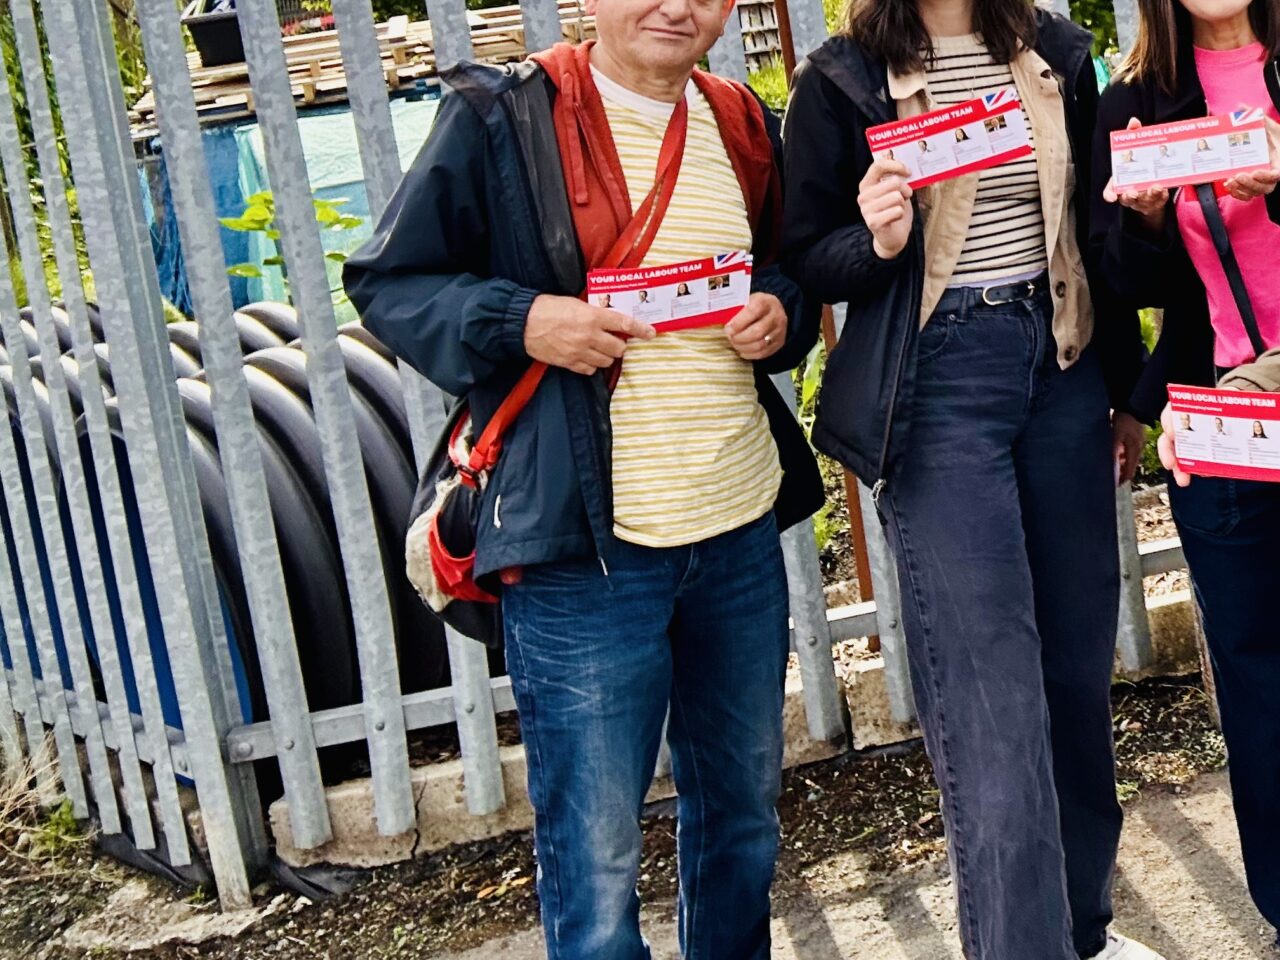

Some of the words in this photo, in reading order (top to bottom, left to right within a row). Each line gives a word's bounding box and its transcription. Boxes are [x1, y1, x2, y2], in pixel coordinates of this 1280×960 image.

[869, 131, 893, 142] YOUR
[893, 123, 919, 135] LOCAL
[919, 113, 950, 129] LABOUR
[950, 106, 973, 118] TEAM
[1113, 133, 1137, 142] YOUR
[1137, 128, 1163, 138] LOCAL
[1163, 123, 1196, 134] LABOUR
[1196, 119, 1219, 128] TEAM
[590, 275, 615, 284] YOUR
[616, 273, 644, 282] LOCAL
[645, 267, 679, 279] LABOUR
[679, 263, 702, 273] TEAM
[1170, 391, 1193, 400] YOUR
[1193, 393, 1218, 403] LOCAL
[1218, 395, 1250, 406] LABOUR
[1250, 398, 1276, 407] TEAM
